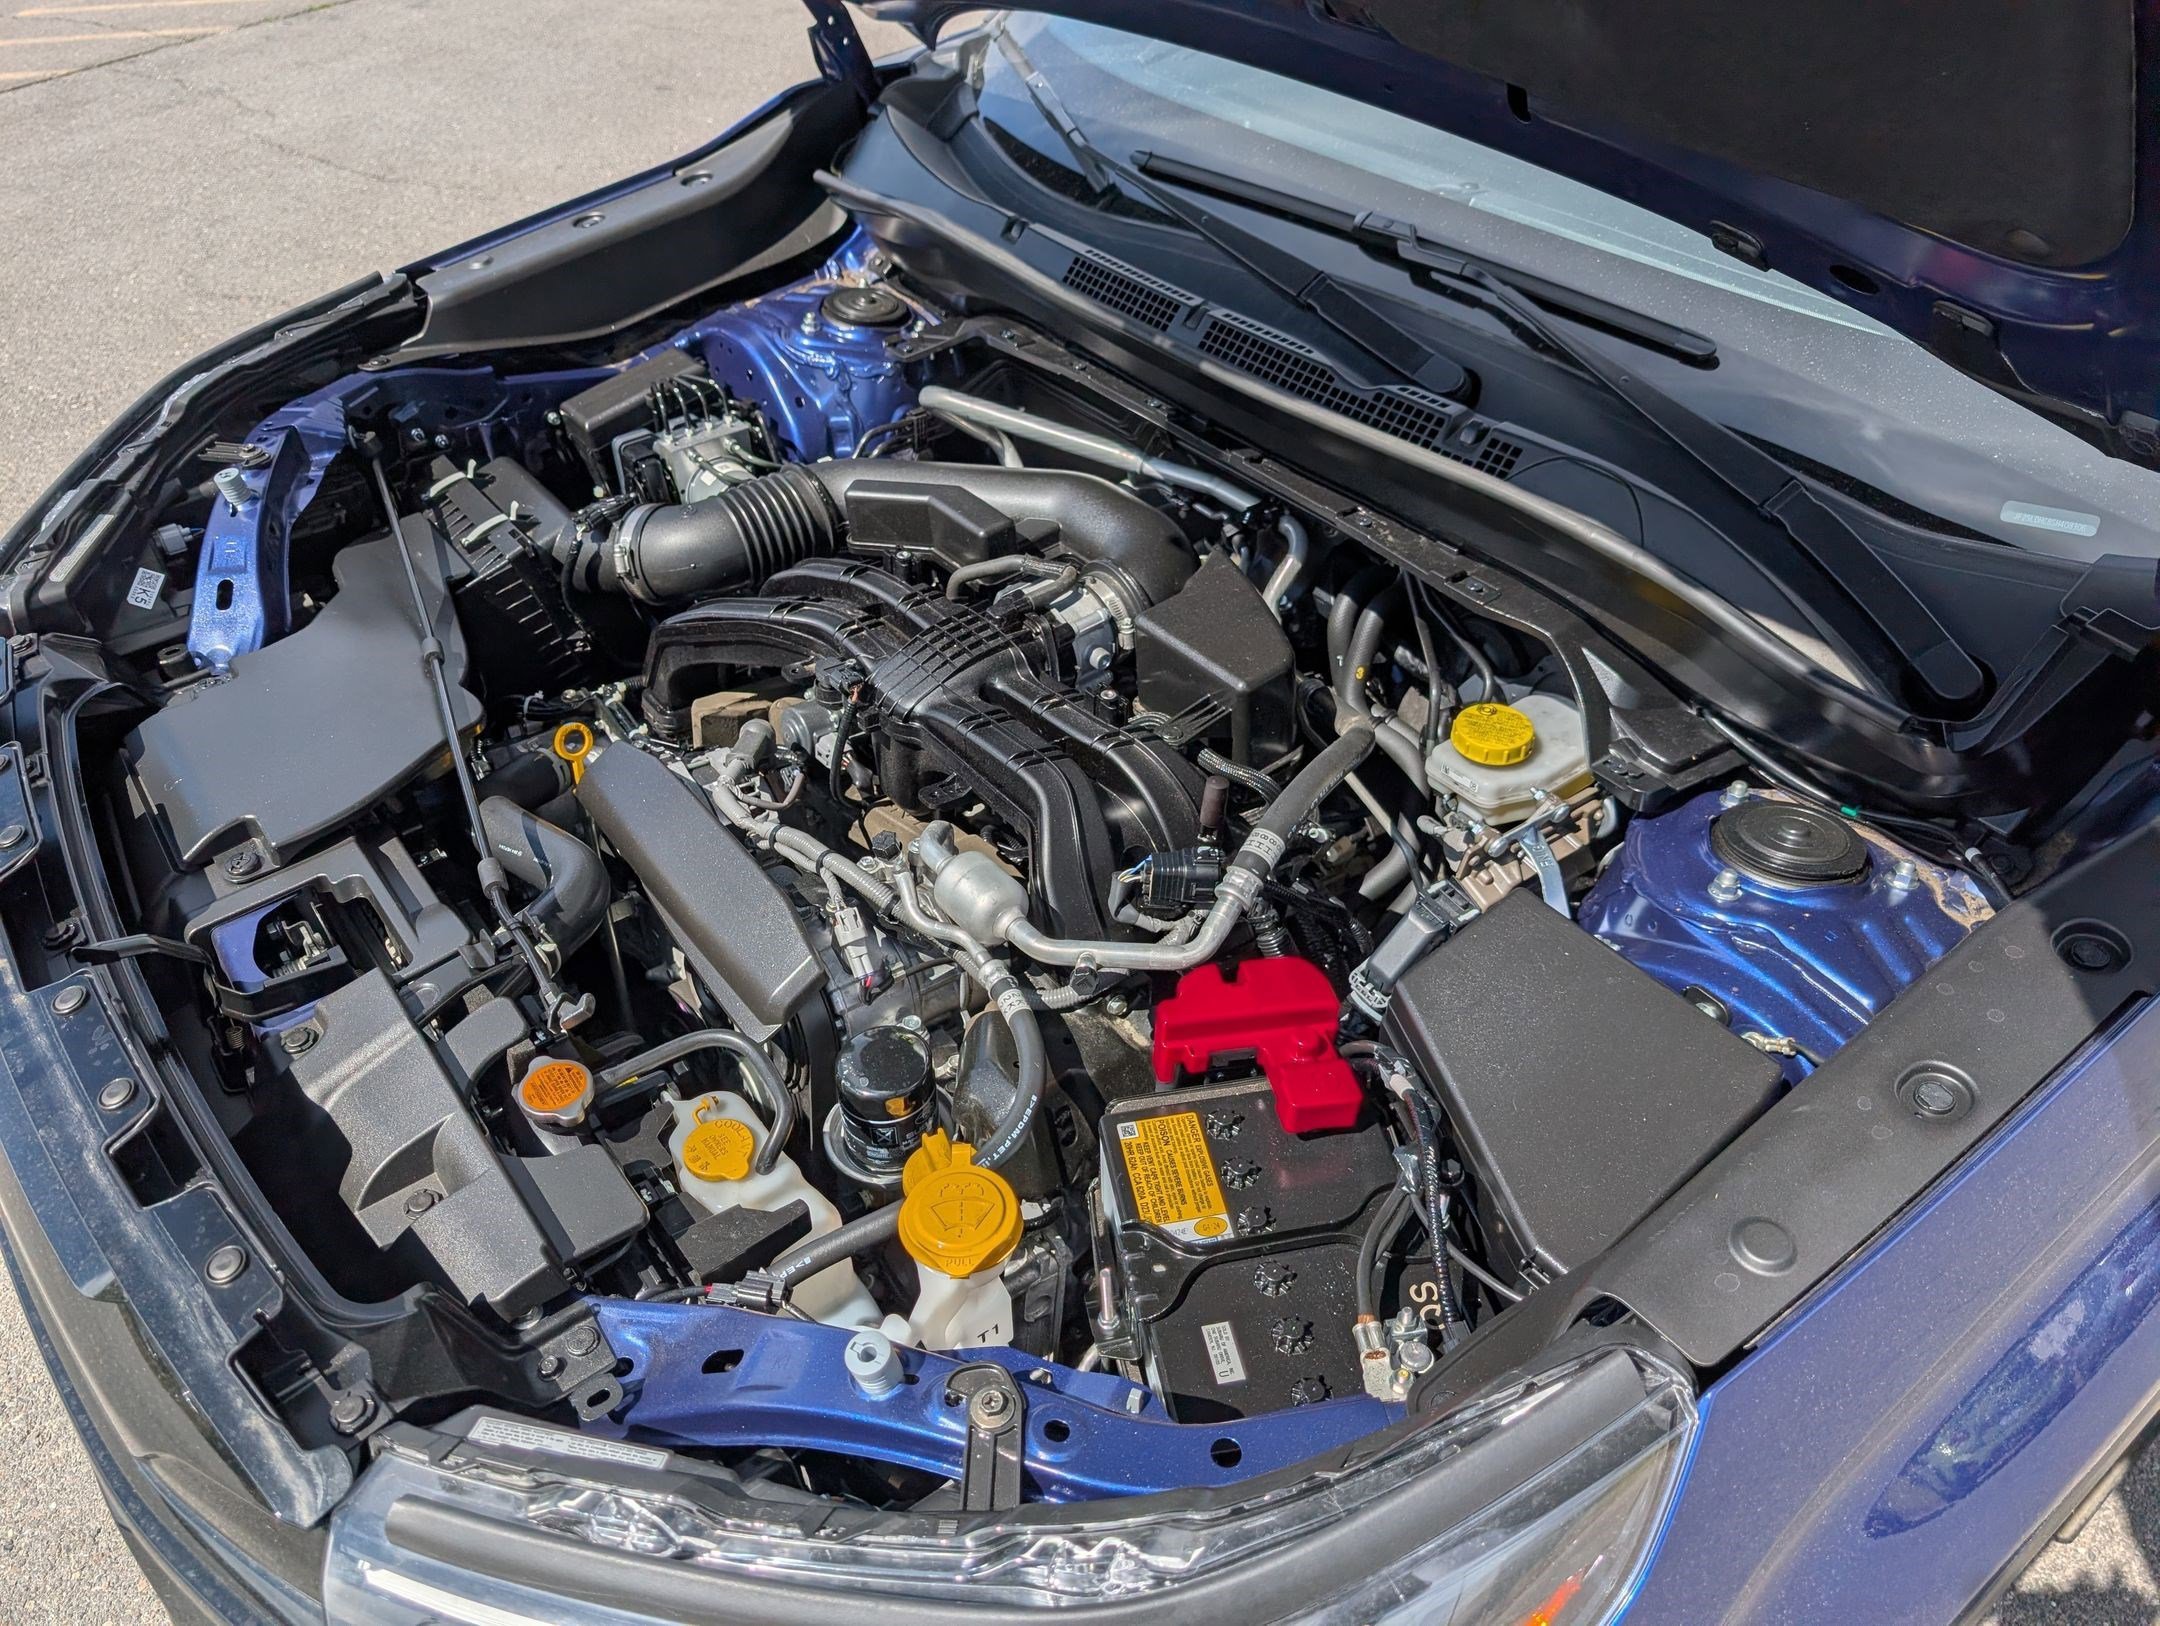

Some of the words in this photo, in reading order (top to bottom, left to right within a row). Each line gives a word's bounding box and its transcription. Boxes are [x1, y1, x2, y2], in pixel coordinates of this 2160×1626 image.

[1156, 1118, 1171, 1146] POISON
[1165, 1148, 1176, 1169] CAUSES
[1186, 1114, 1200, 1143] DANGER
[1203, 1169, 1213, 1187] GASES
[1132, 1172, 1142, 1185] CCA
